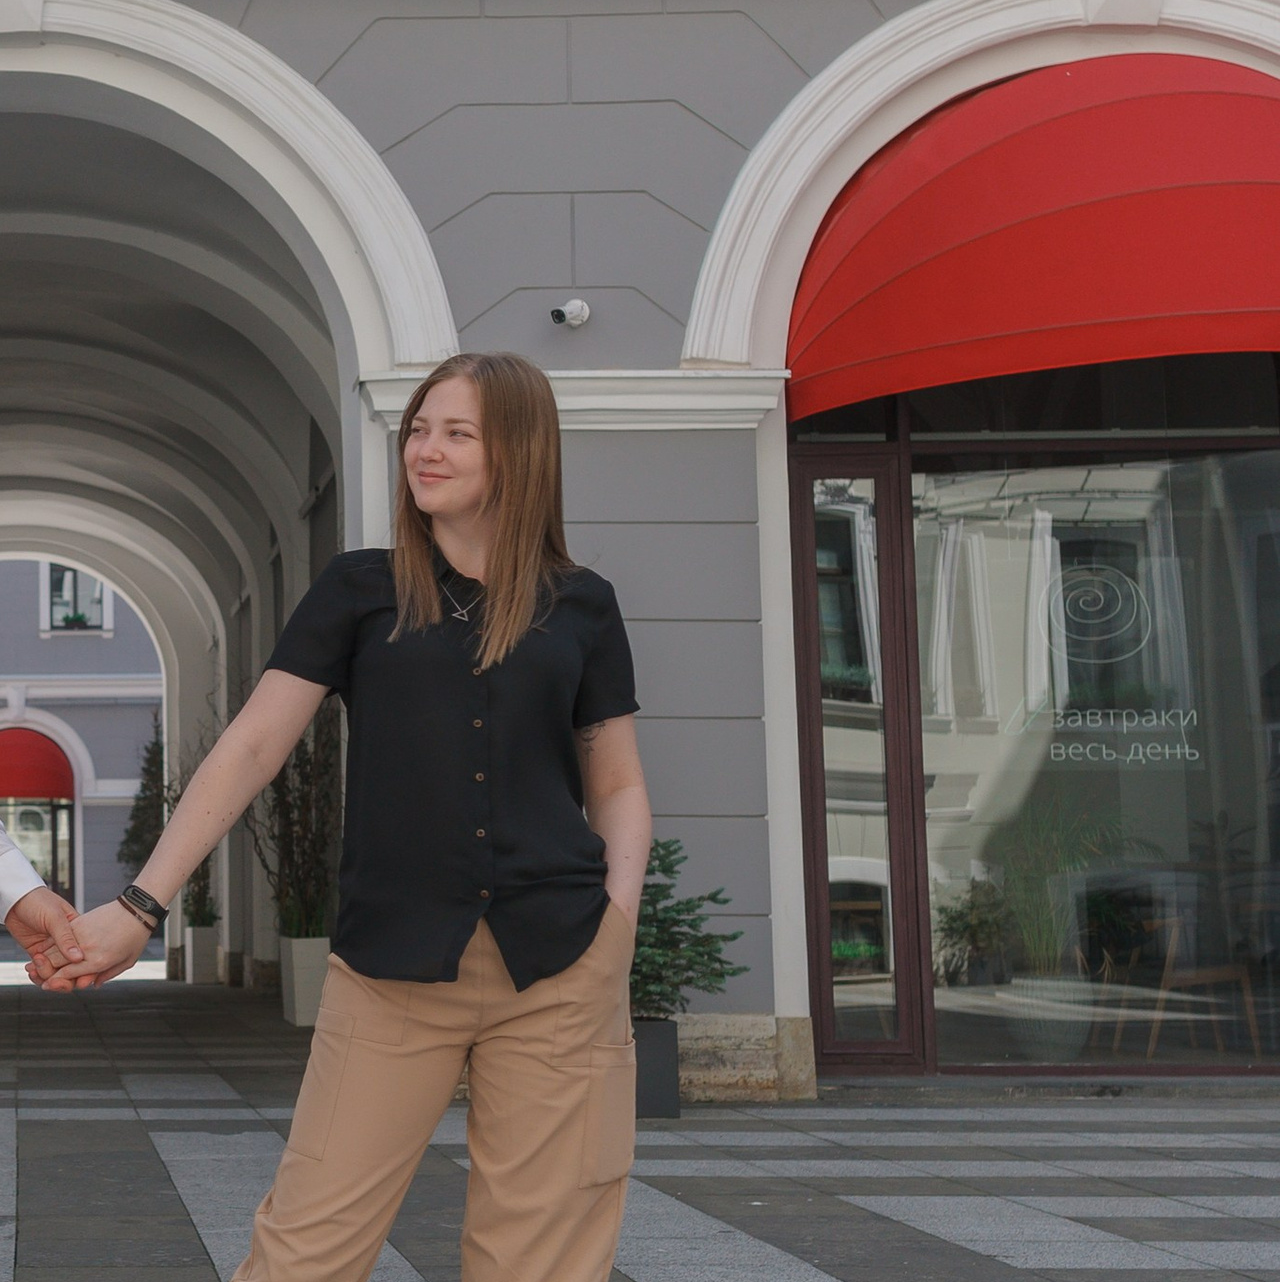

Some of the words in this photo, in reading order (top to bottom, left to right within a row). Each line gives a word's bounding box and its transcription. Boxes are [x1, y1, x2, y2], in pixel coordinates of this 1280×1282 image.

[1051, 708, 1198, 734] завтраки
[1050, 742, 1117, 761] весь
[1126, 742, 1200, 764] день
